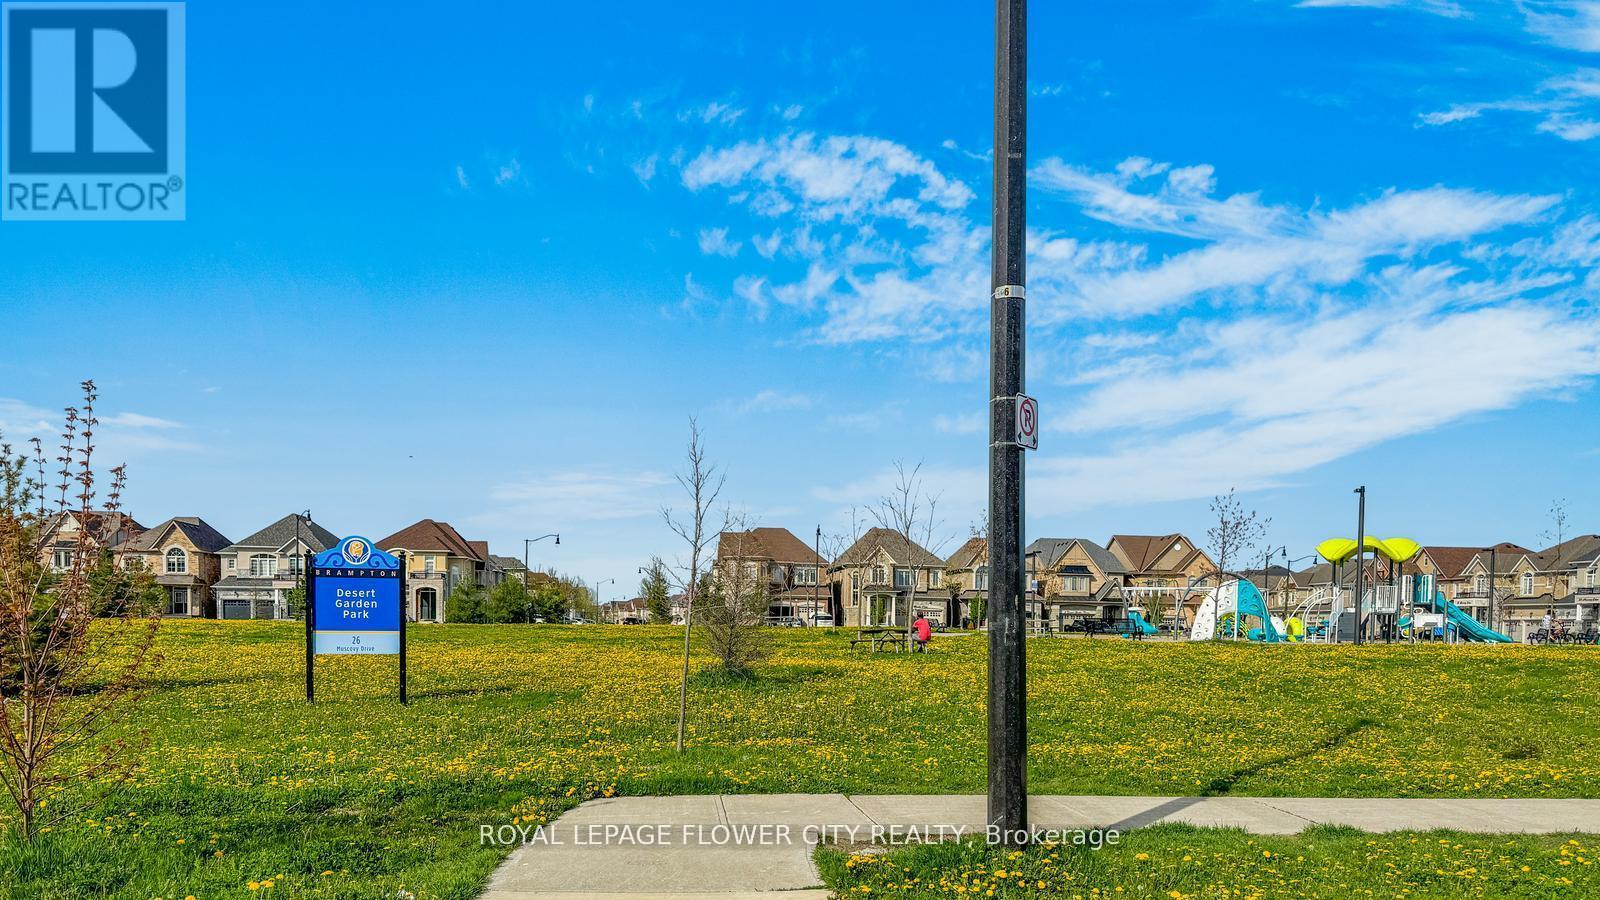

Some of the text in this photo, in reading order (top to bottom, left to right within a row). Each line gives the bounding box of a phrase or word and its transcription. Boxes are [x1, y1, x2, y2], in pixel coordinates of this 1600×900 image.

[315, 569, 397, 577] BRAMPTON
[336, 588, 376, 598] Desert
[335, 599, 378, 609] Garden
[343, 610, 369, 619] Park
[351, 635, 361, 645] 26
